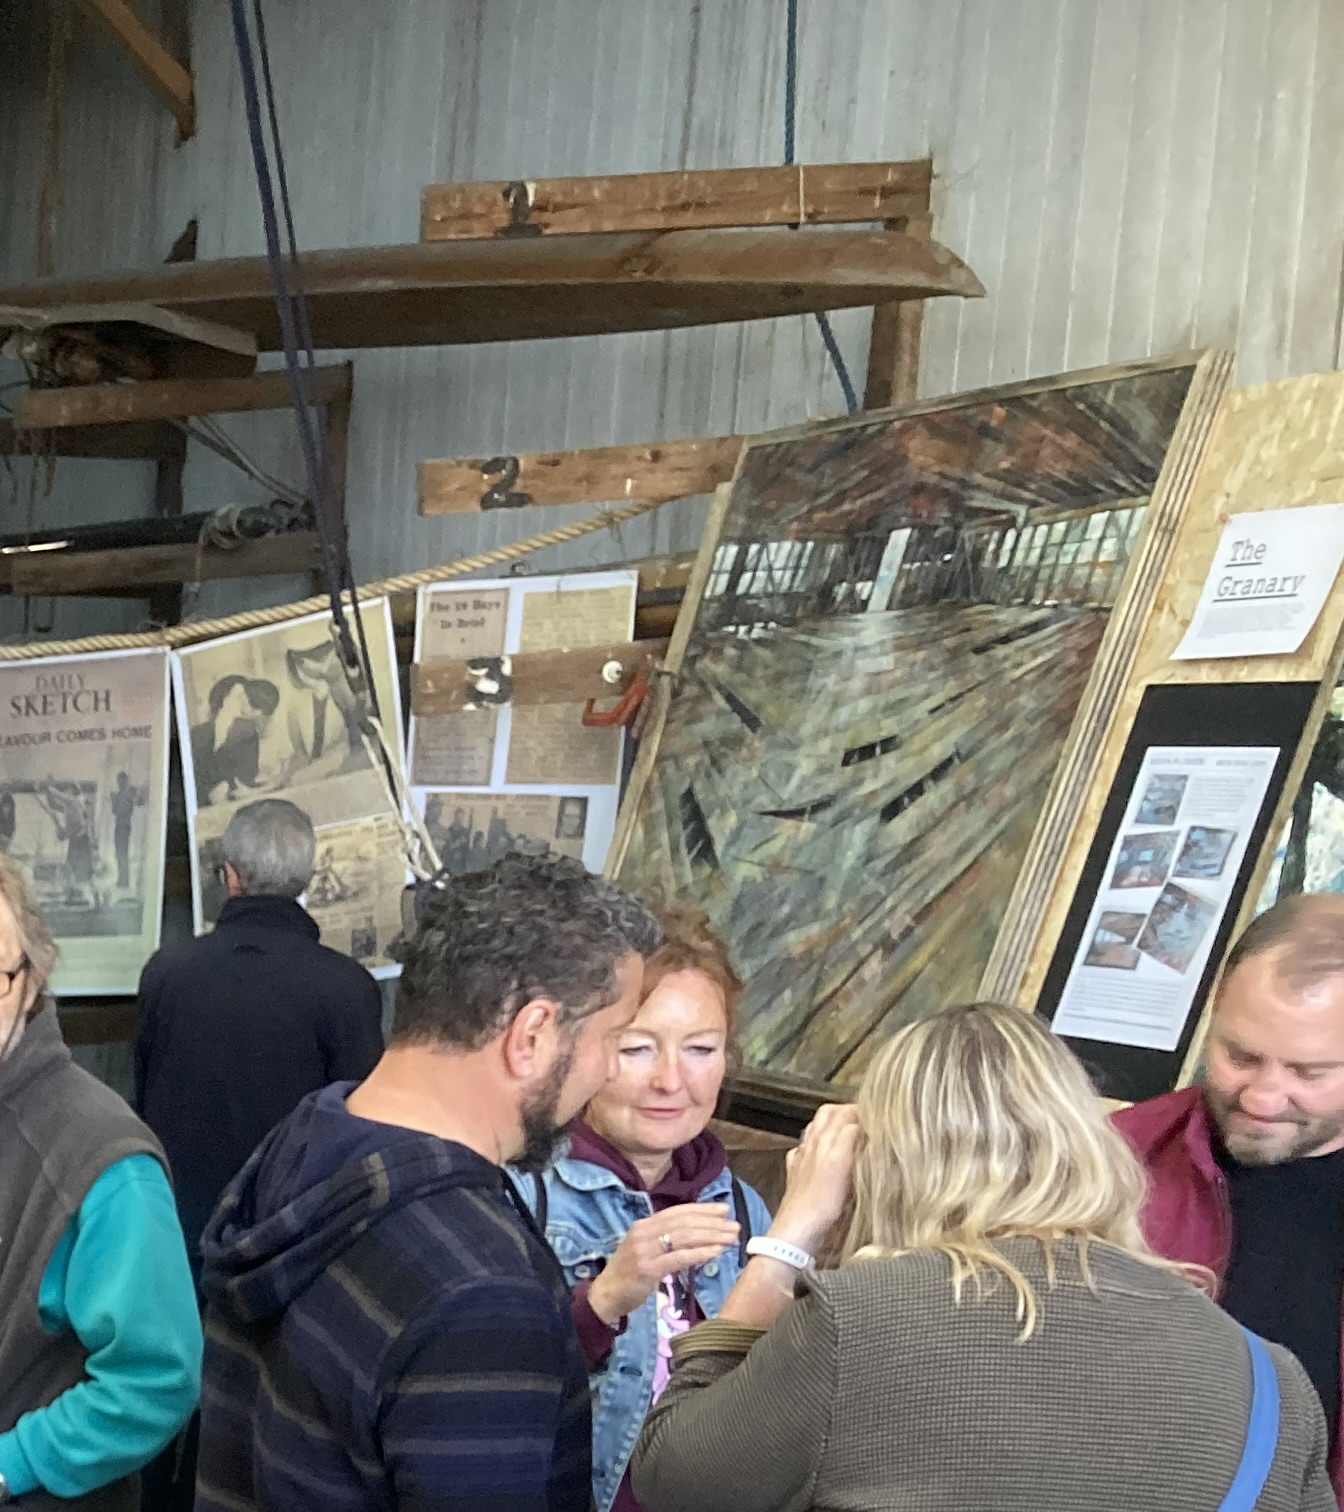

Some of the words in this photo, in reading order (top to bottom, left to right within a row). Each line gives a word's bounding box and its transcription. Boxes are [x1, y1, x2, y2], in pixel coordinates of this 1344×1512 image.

[494, 180, 545, 239] 1
[478, 455, 533, 511] 2
[1230, 539, 1267, 562] The
[1216, 574, 1306, 598] Granary
[34, 673, 88, 693] DAILY
[9, 688, 112, 719] SKETCH
[56, 726, 106, 744] COMES
[112, 724, 153, 740] HOME
